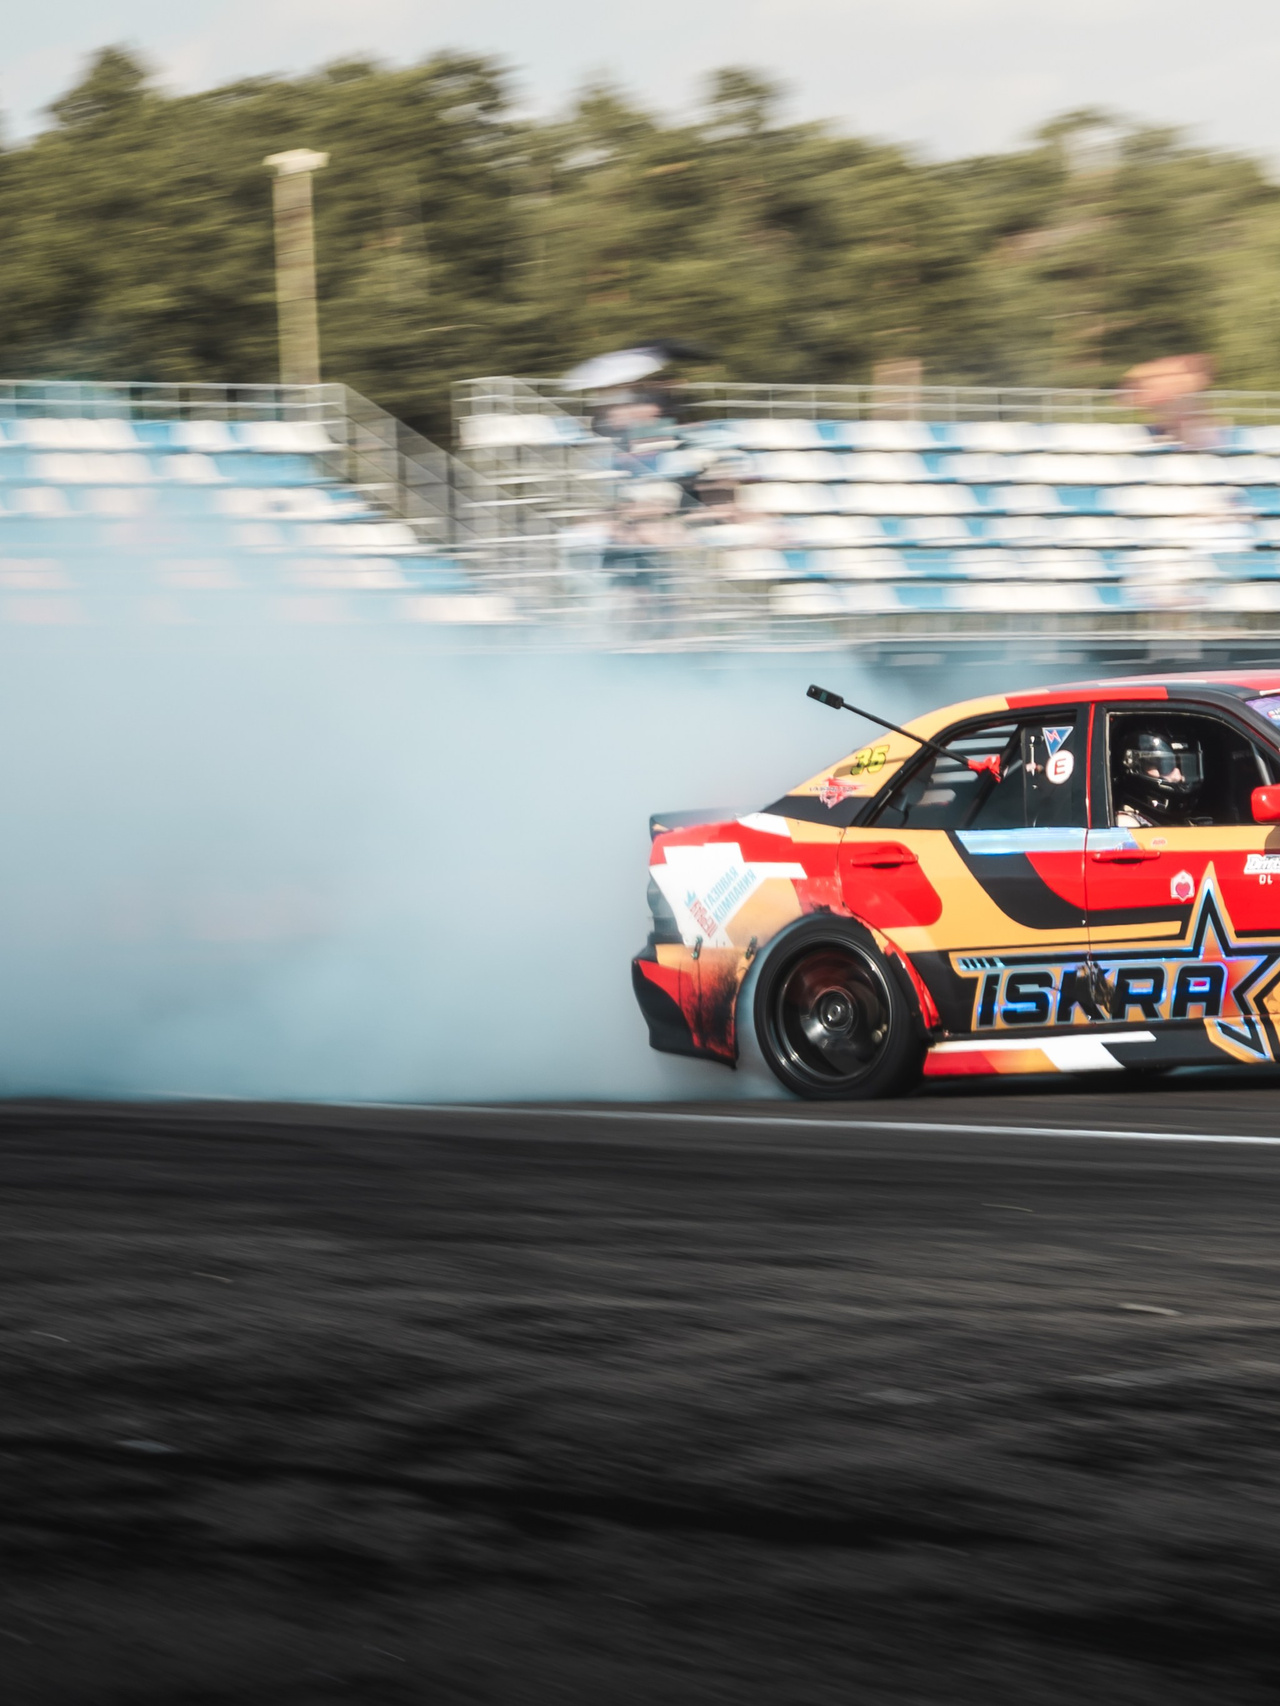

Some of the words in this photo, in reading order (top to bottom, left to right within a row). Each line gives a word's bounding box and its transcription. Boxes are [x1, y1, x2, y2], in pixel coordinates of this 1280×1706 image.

[850, 744, 890, 776] 35
[1054, 758, 1067, 776] E
[703, 865, 739, 911] ГАЗОВАЯ
[713, 868, 757, 923] КОМПАНИЯ
[1258, 874, 1273, 885] DL
[976, 963, 1228, 1029] ISKRA
